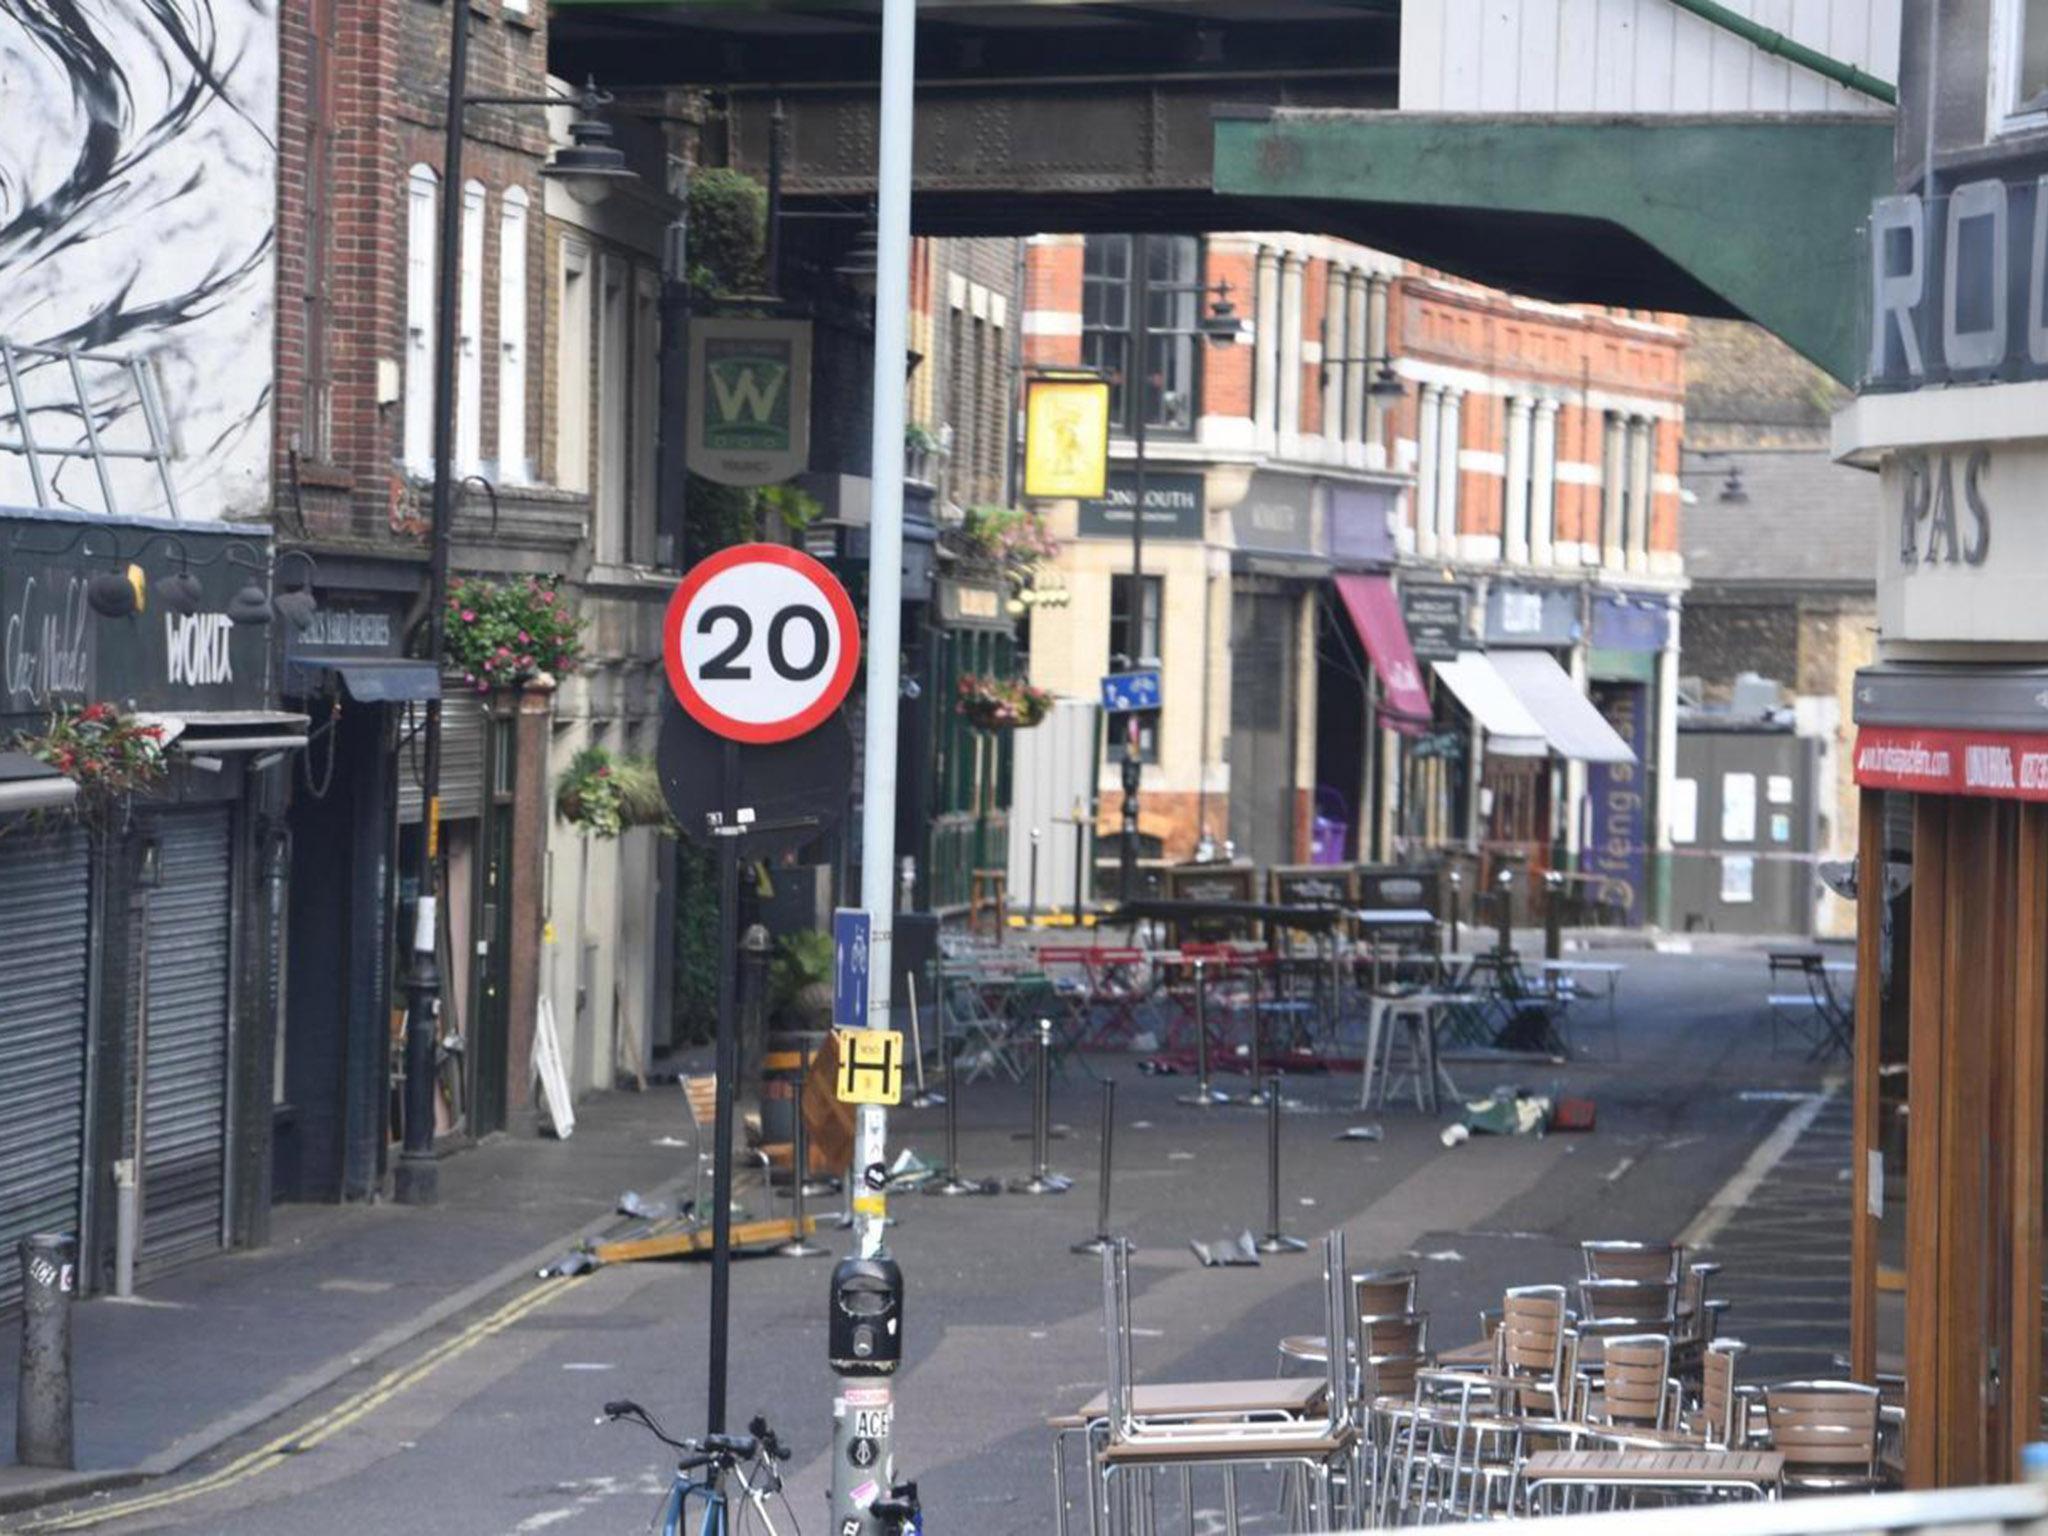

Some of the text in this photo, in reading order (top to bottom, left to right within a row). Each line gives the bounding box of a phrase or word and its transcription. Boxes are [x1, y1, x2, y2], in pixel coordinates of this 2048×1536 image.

[708, 363, 788, 422] W
[1901, 449, 1991, 568] PAS
[165, 612, 235, 686] WOKIT
[697, 604, 830, 682] 20
[848, 1037, 891, 1095] H
[858, 1411, 887, 1436] ACE
